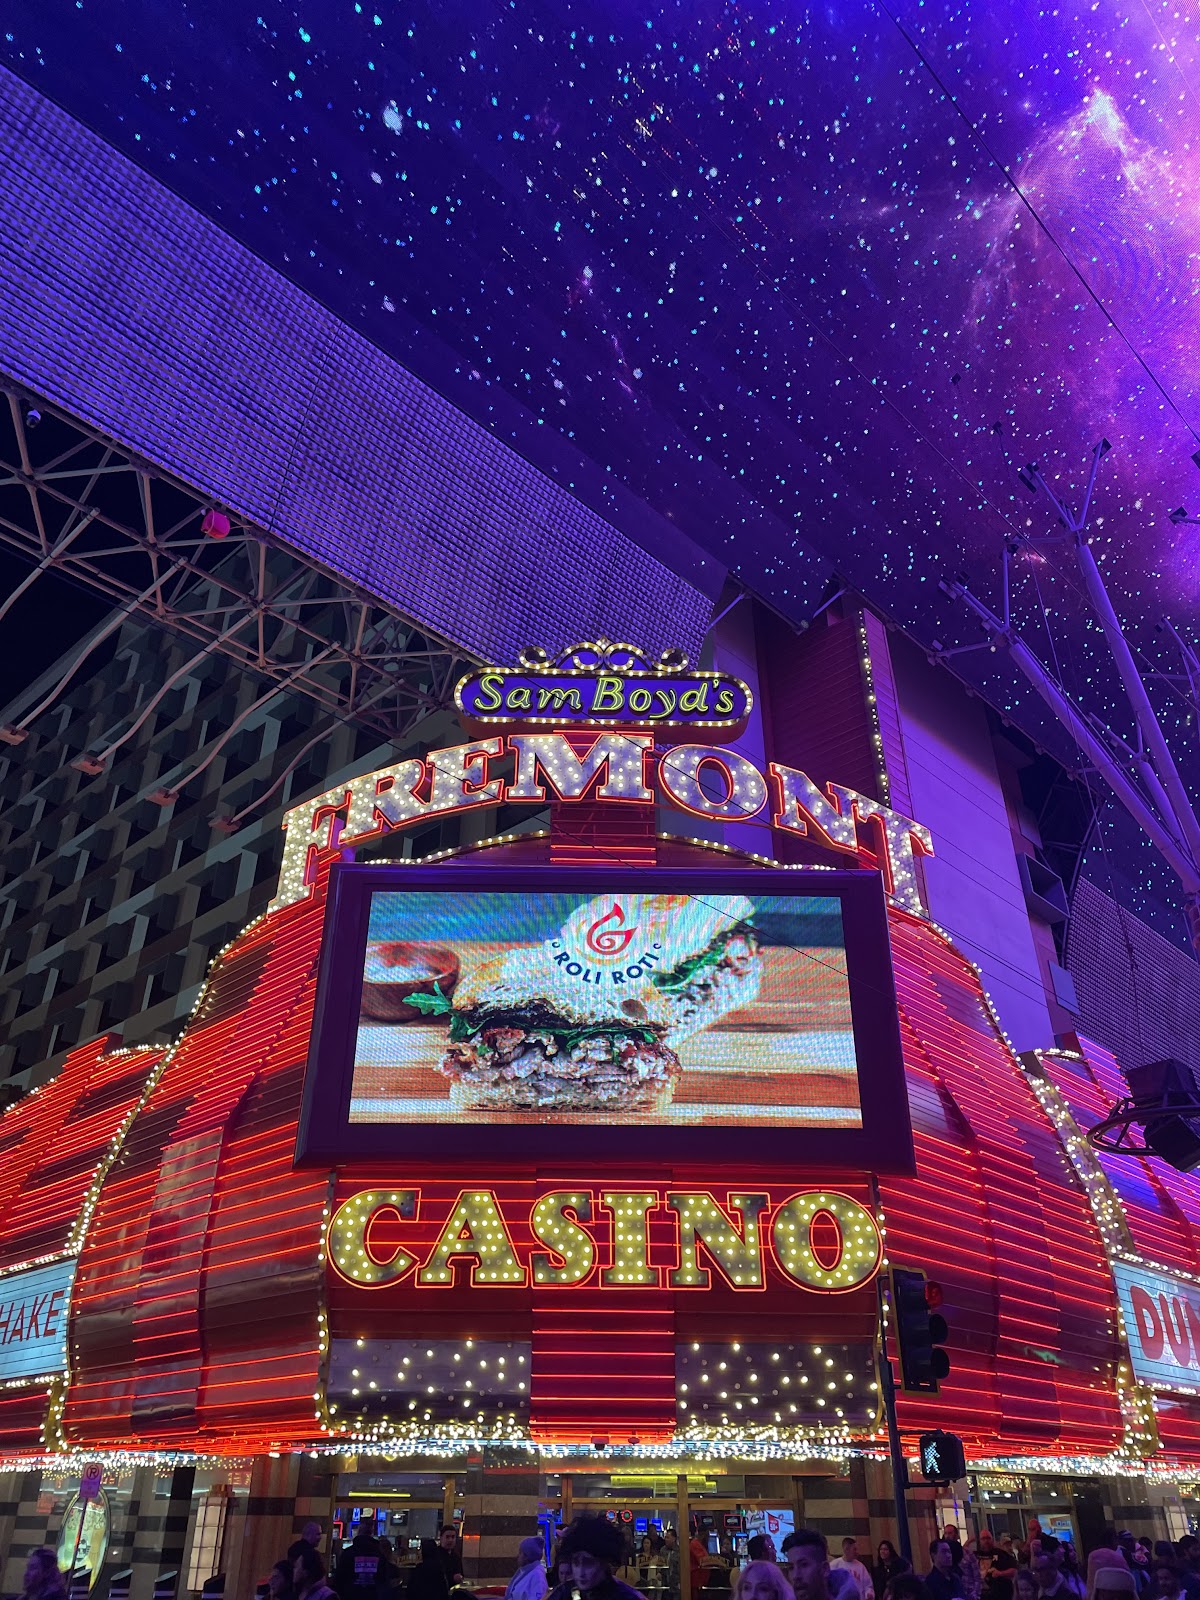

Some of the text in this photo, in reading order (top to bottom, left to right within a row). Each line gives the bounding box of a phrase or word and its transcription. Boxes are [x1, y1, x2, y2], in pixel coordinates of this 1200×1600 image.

[473, 673, 735, 719] Sam Boyd's
[267, 730, 936, 920] FREMONT
[553, 951, 661, 985] ROLI ROTI
[327, 1187, 884, 1294] CASINO
